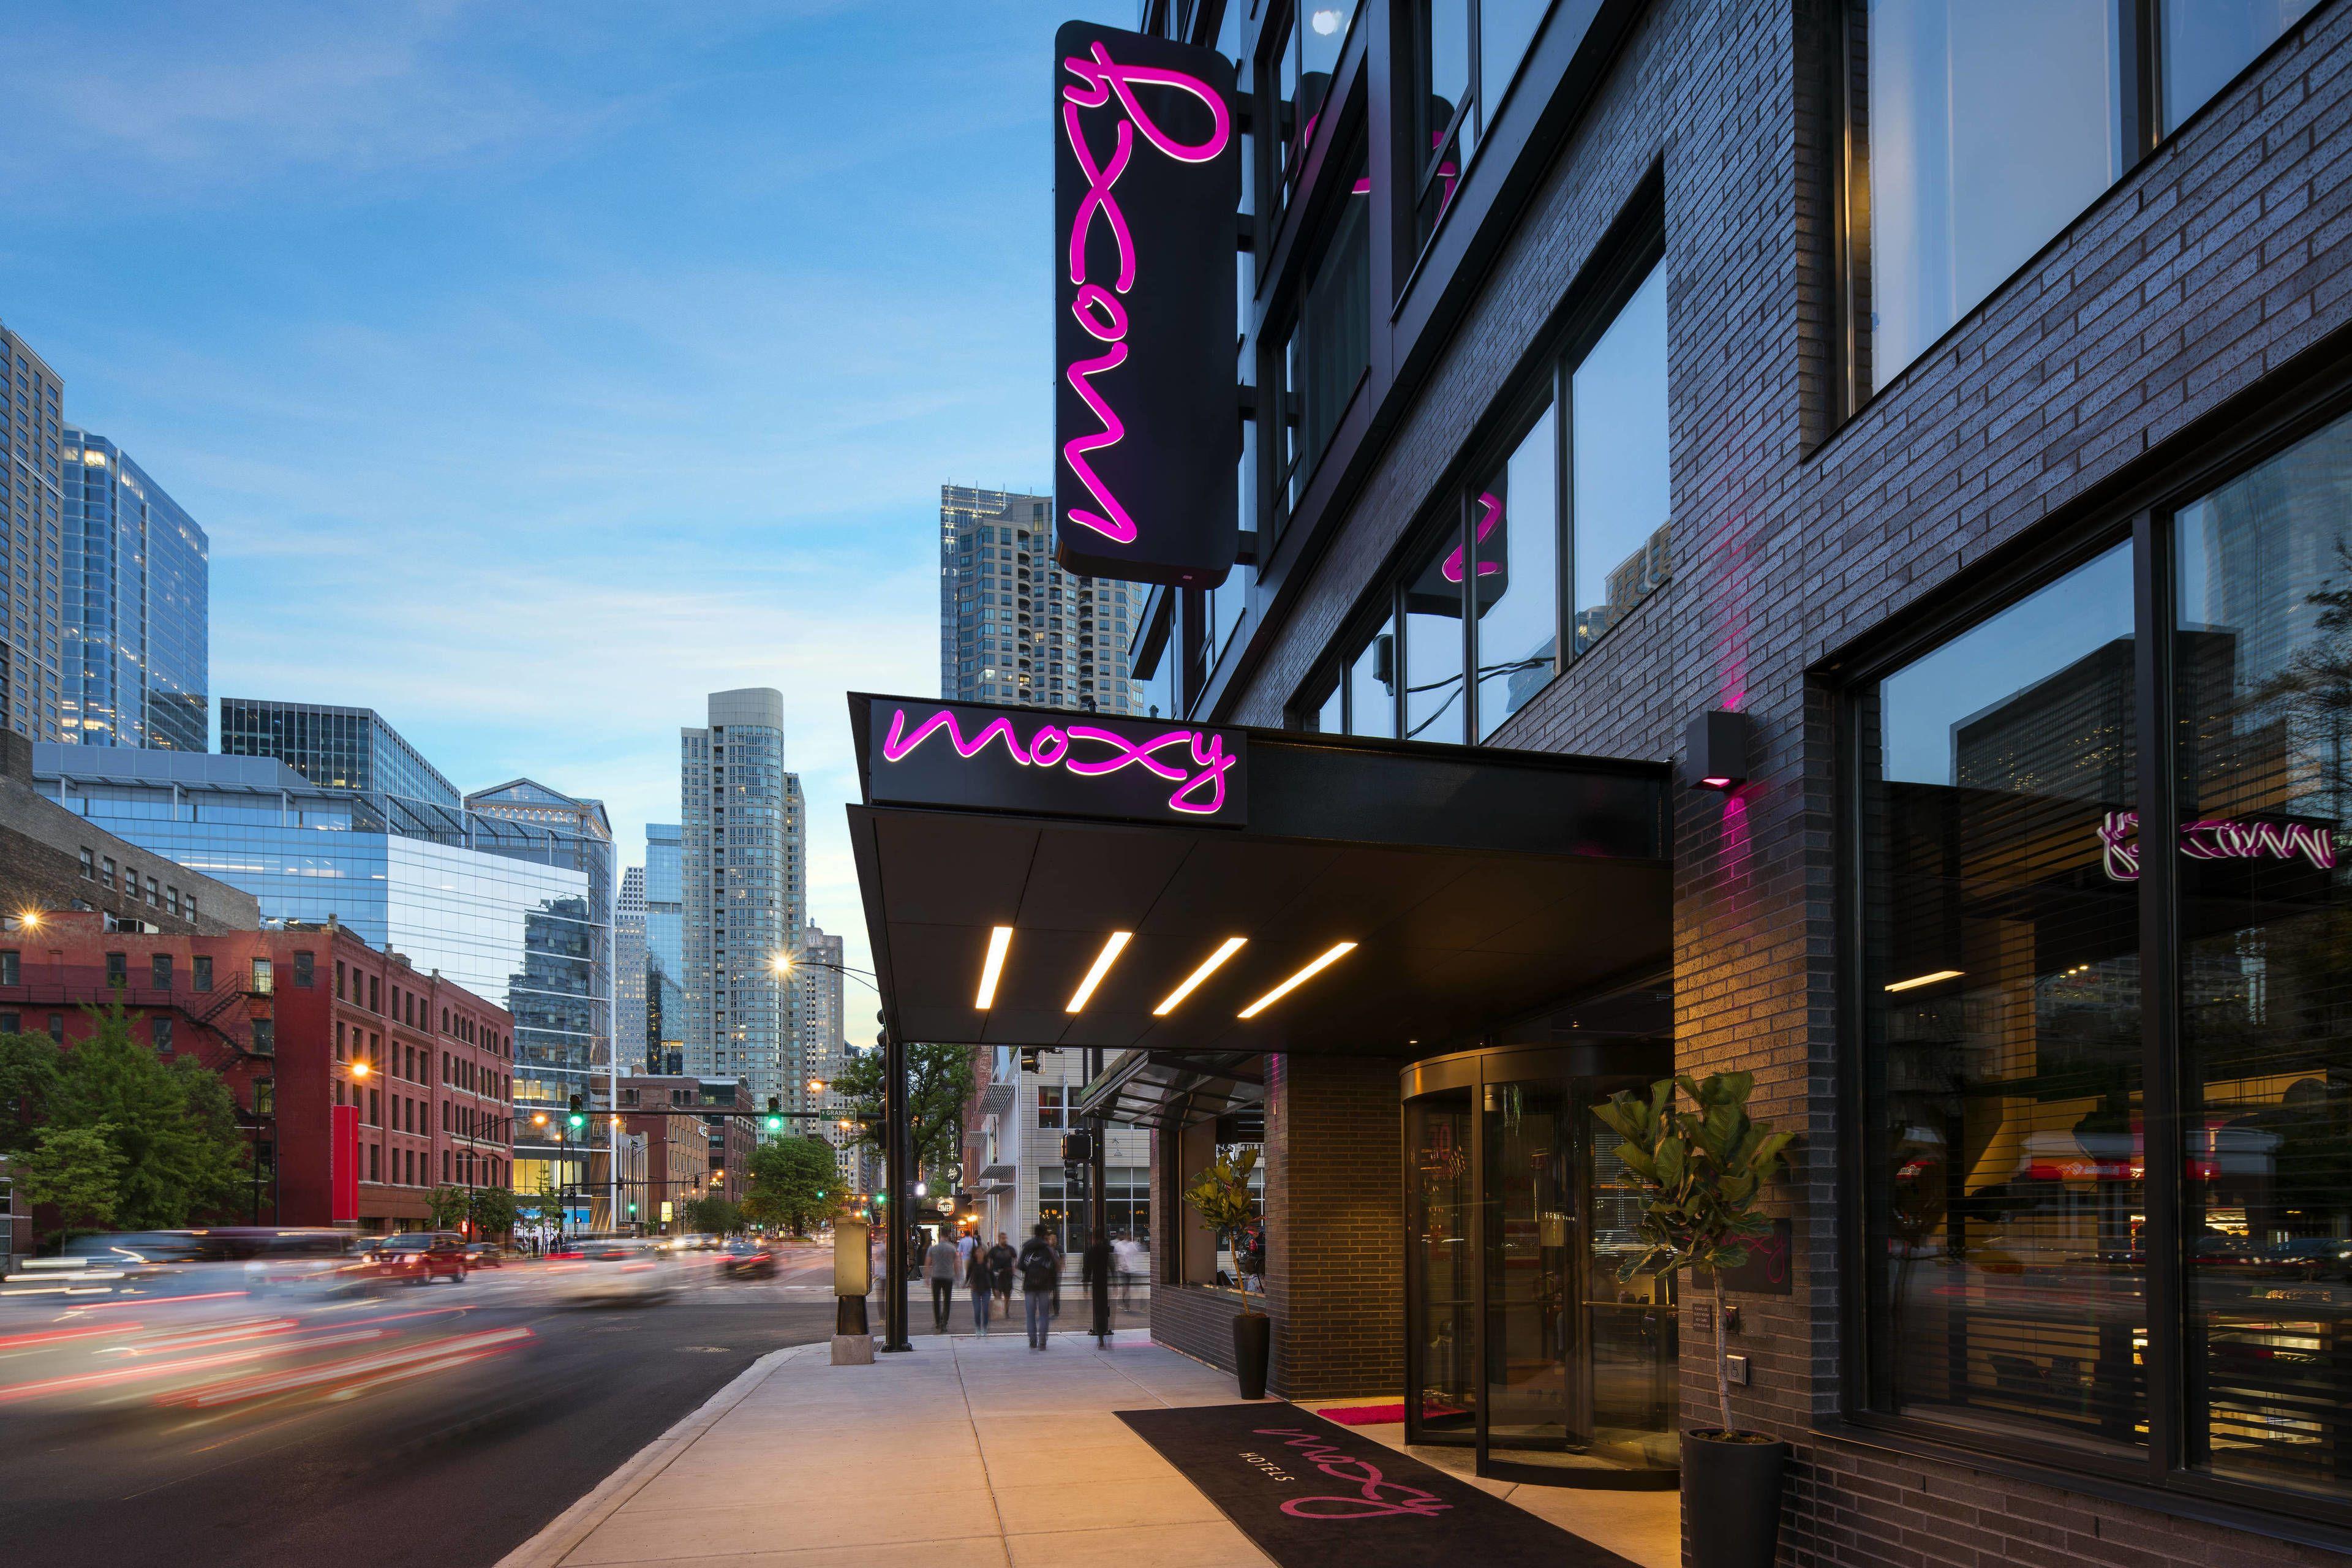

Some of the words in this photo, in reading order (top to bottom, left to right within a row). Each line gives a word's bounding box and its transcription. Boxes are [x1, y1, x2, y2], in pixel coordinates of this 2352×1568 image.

[1063, 40, 1230, 544] moxy
[883, 709, 1237, 815] moxy
[1238, 1452, 1295, 1482] HOTELS
[1252, 1428, 1454, 1519] moxy
